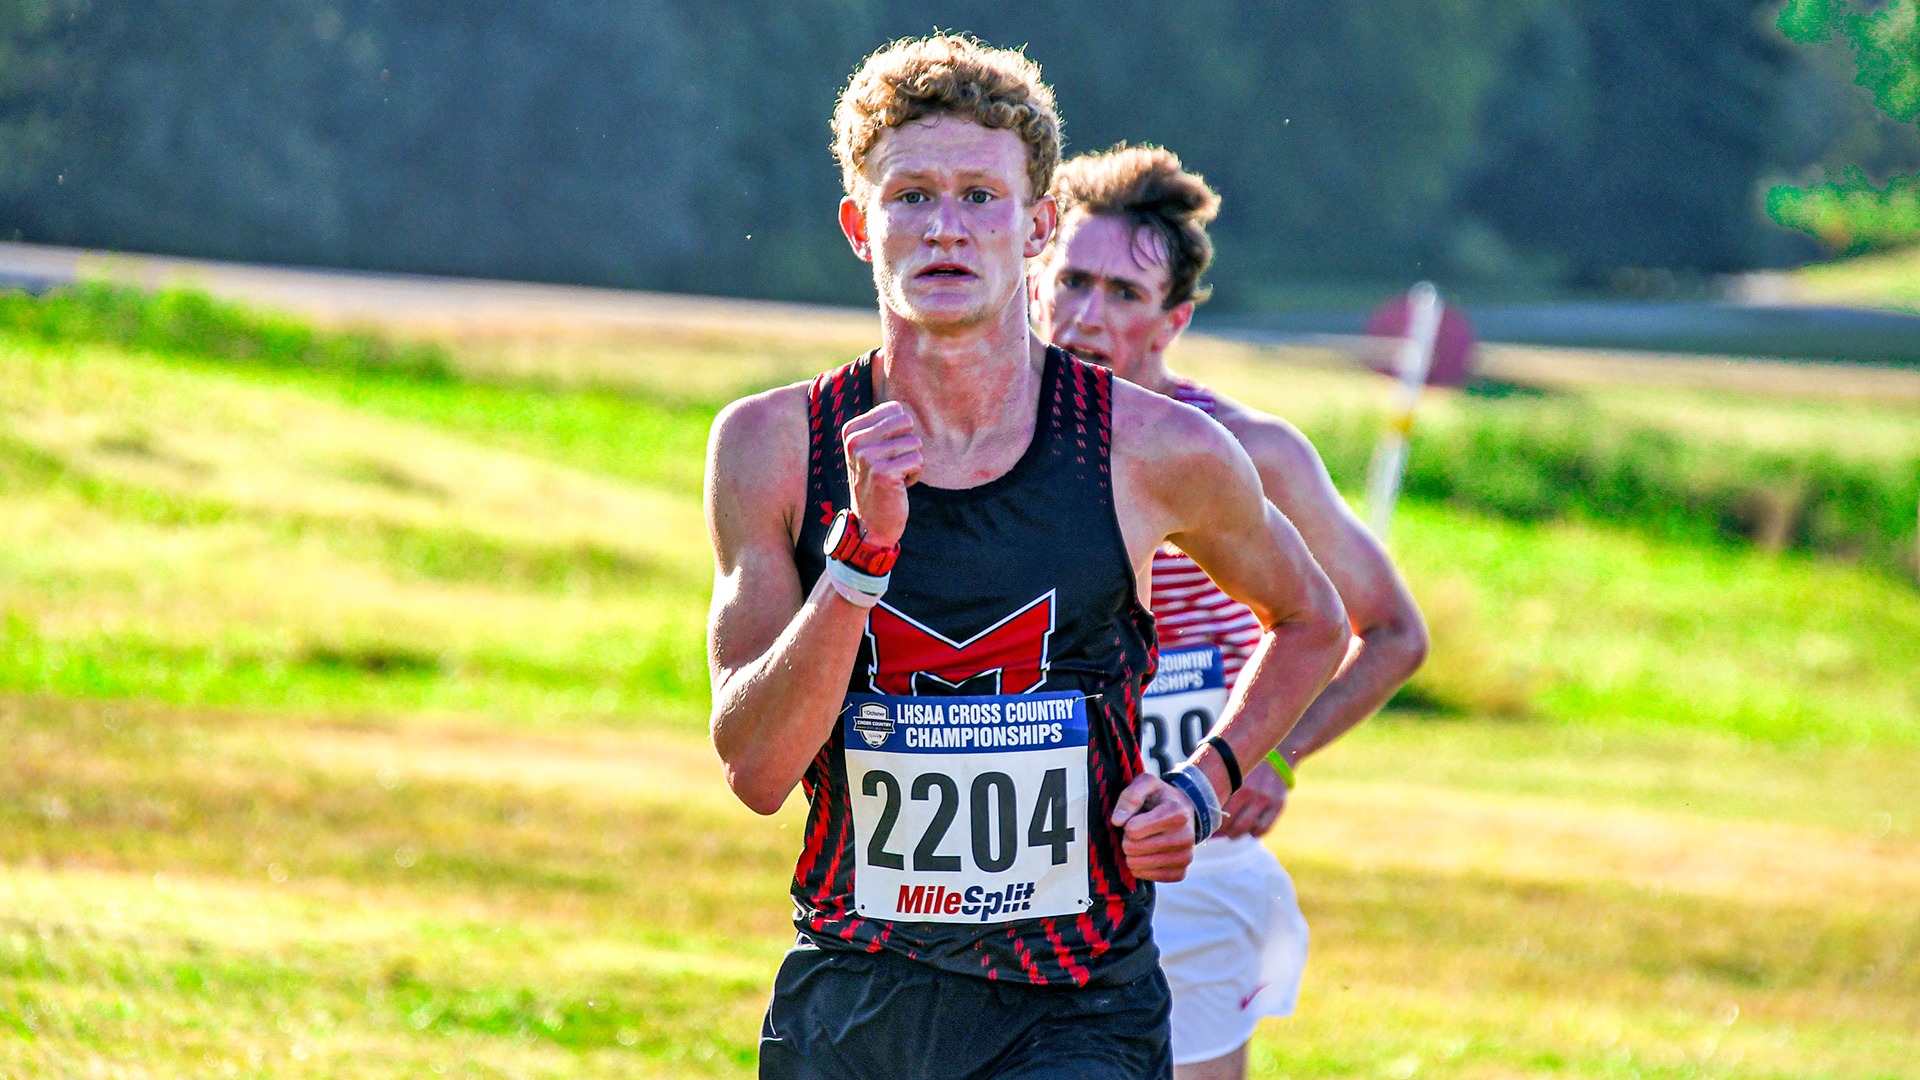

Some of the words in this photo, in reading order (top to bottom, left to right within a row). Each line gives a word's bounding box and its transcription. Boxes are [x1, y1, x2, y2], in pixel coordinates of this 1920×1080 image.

[897, 703, 945, 725] LHSAA
[951, 702, 1004, 724] CROSS
[1008, 699, 1074, 722] COUNTRY
[905, 724, 1063, 748] CHAMPIONSHIPS
[862, 768, 1075, 873] 2204
[896, 882, 1035, 921] MileSplit
